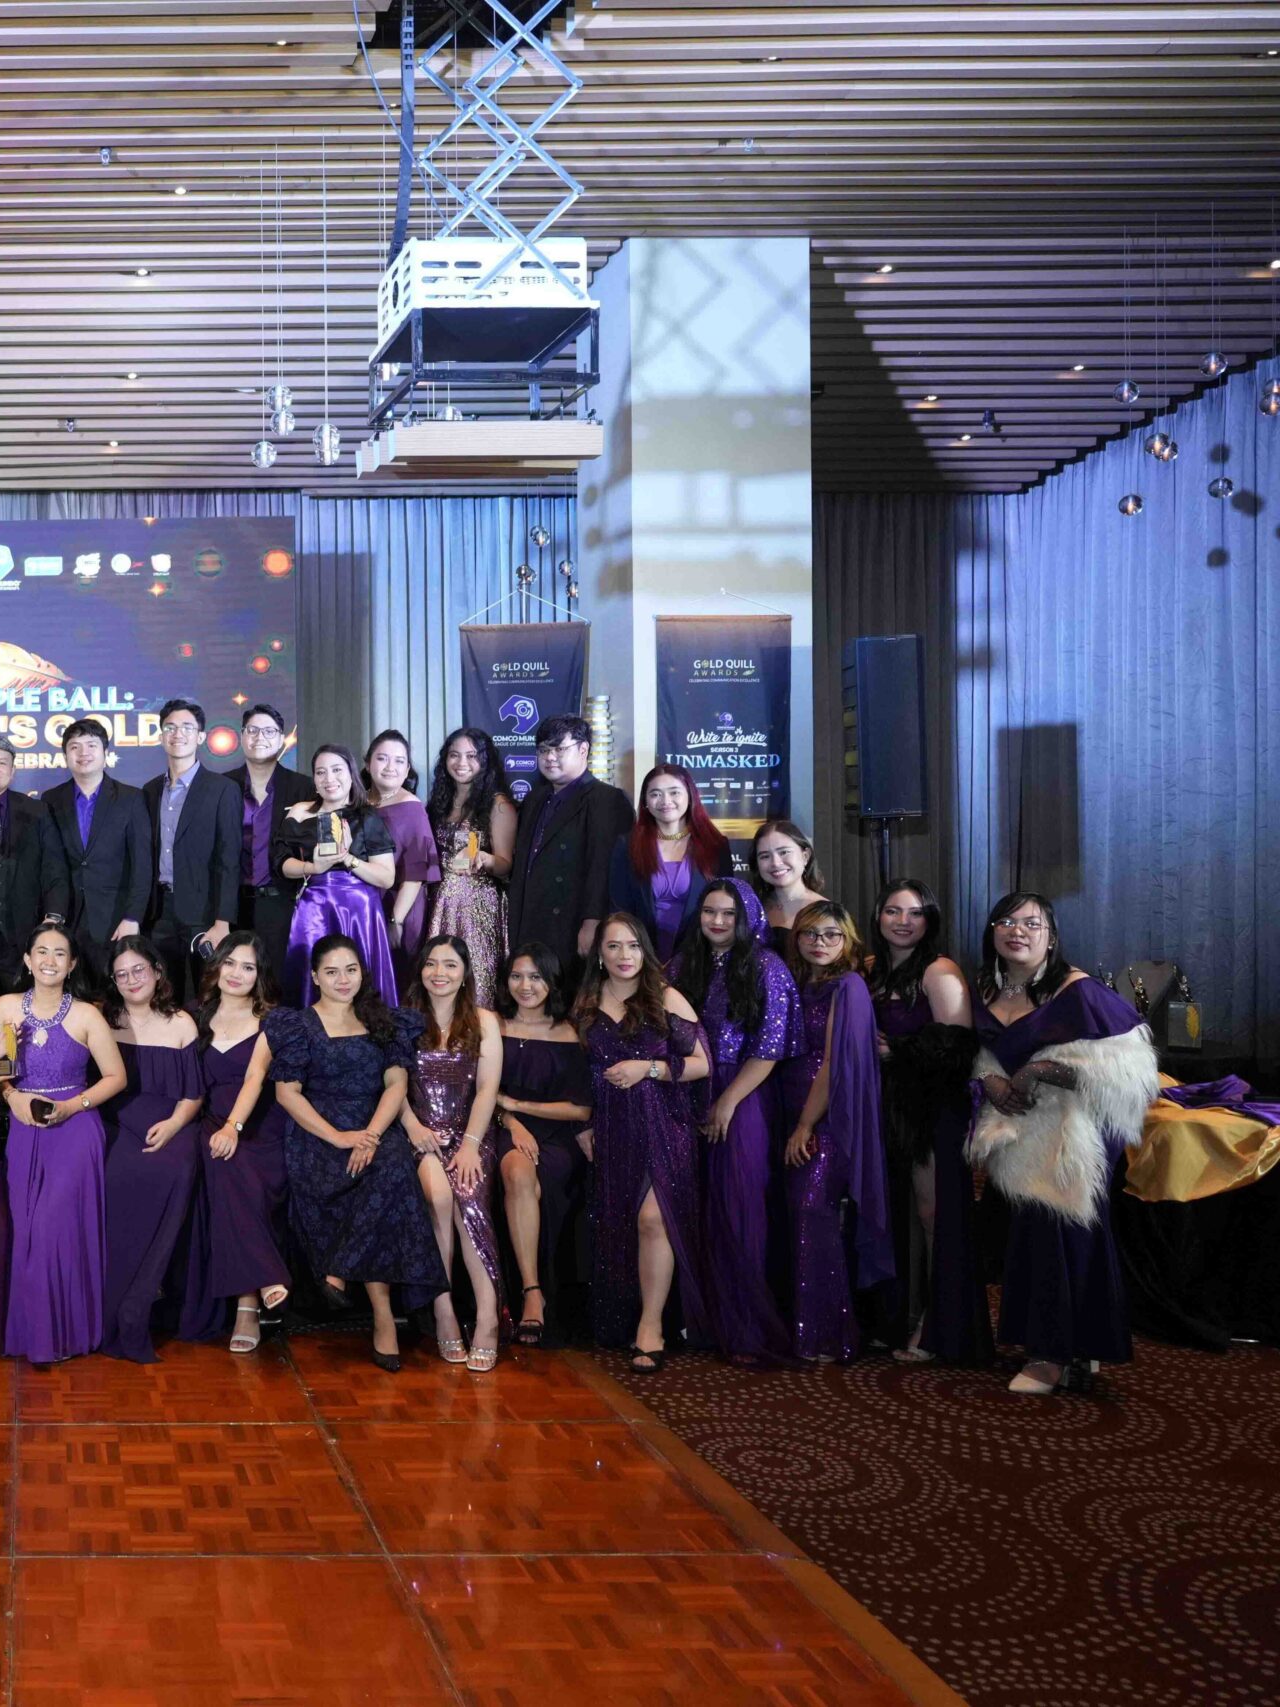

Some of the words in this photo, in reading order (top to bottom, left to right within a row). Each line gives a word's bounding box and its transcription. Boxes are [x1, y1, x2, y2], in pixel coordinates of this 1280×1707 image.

[492, 662, 520, 672] GOLD
[522, 661, 550, 672] QUILL
[693, 660, 723, 669] GOLD
[725, 659, 755, 670] QUILL
[48, 686, 134, 712] BALL:
[686, 729, 720, 744] Write
[722, 732, 730, 742] to
[734, 727, 767, 747] ignite
[665, 754, 780, 768] UNMASKED
